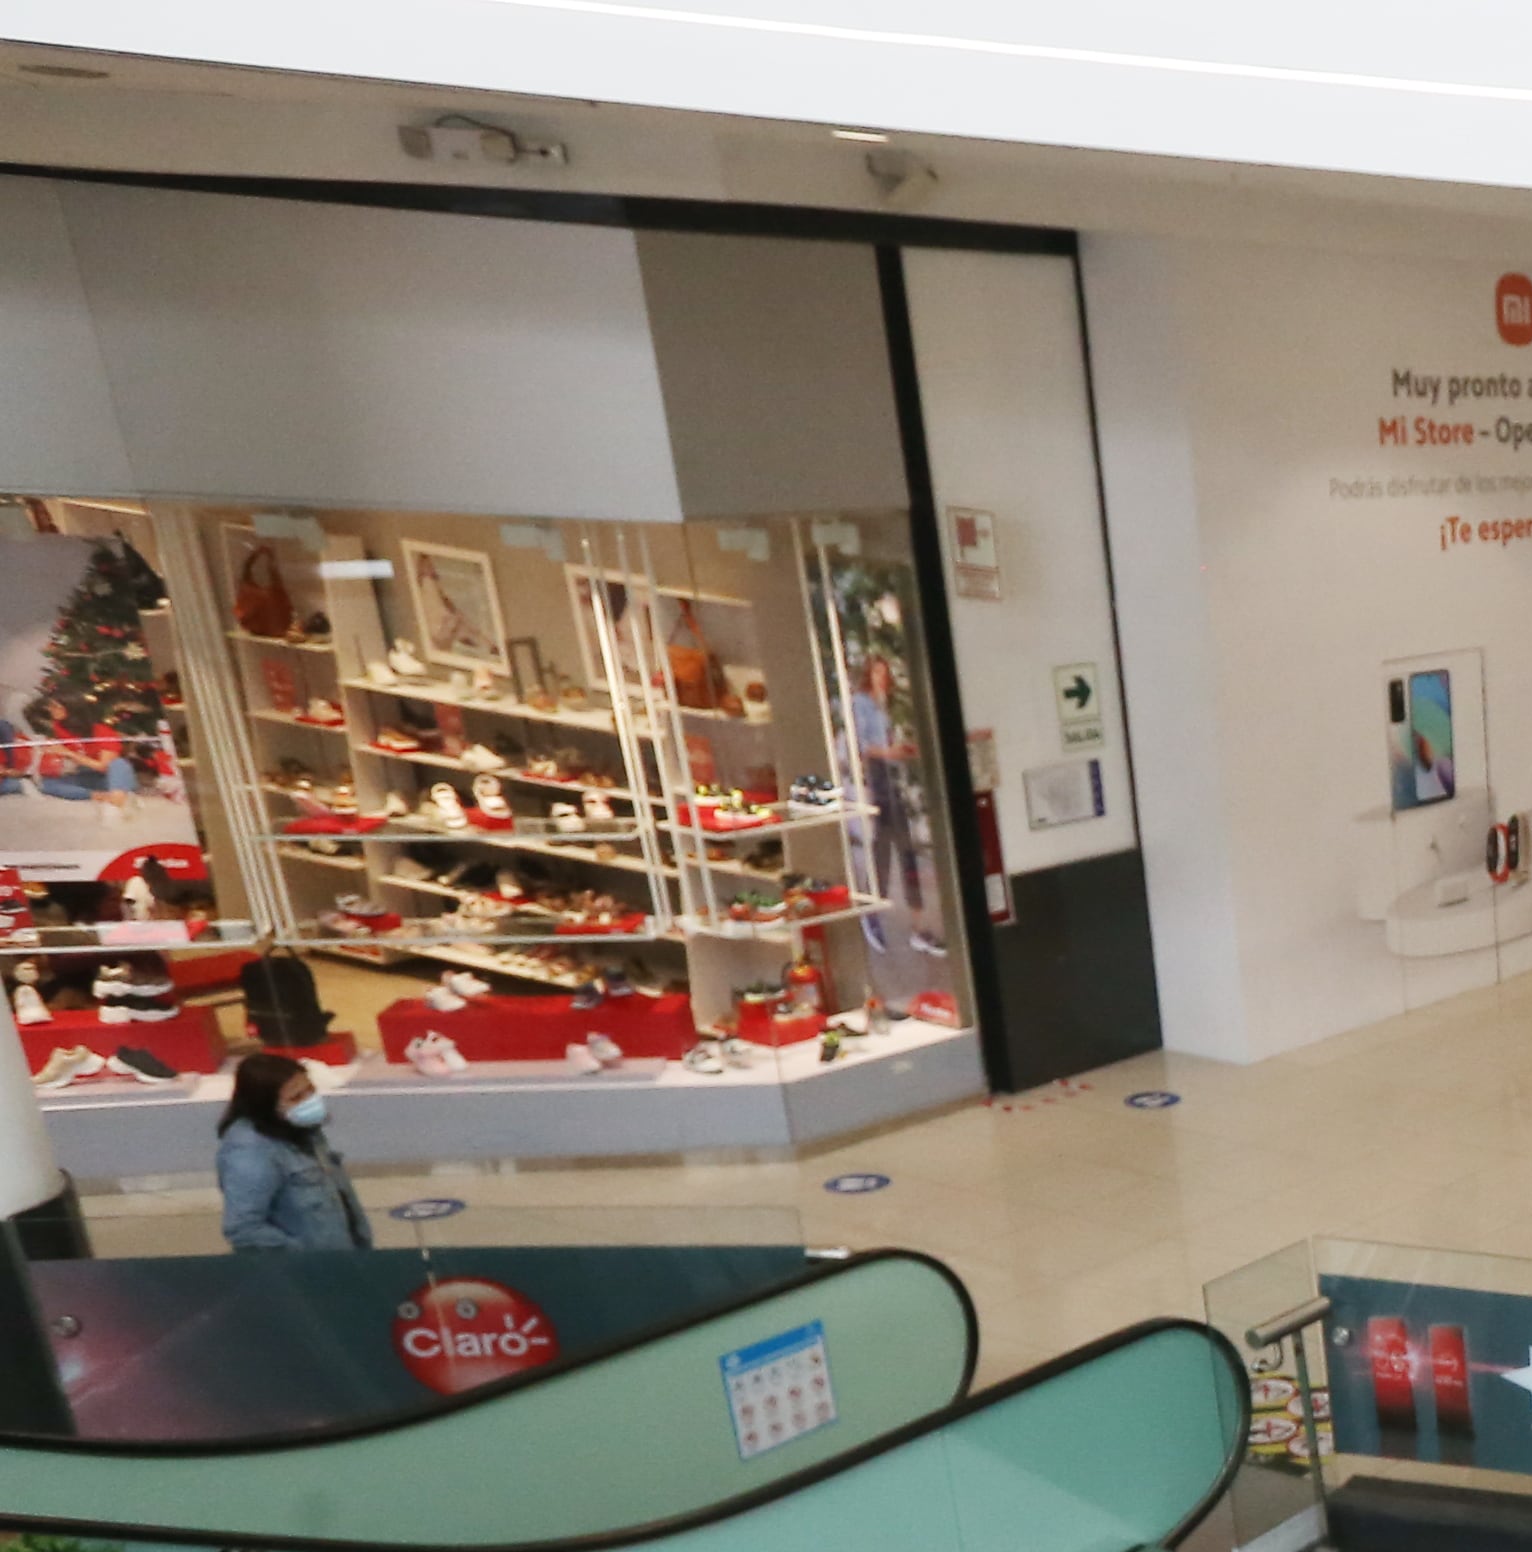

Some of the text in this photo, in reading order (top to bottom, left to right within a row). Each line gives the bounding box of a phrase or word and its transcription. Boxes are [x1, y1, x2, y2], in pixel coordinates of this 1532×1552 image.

[1391, 367, 1441, 406] Muy
[1448, 375, 1522, 406] pronto
[1377, 416, 1407, 446] Mi
[1413, 416, 1475, 446] Store
[1440, 515, 1472, 551] ¡Te
[403, 1322, 530, 1359] Claro
